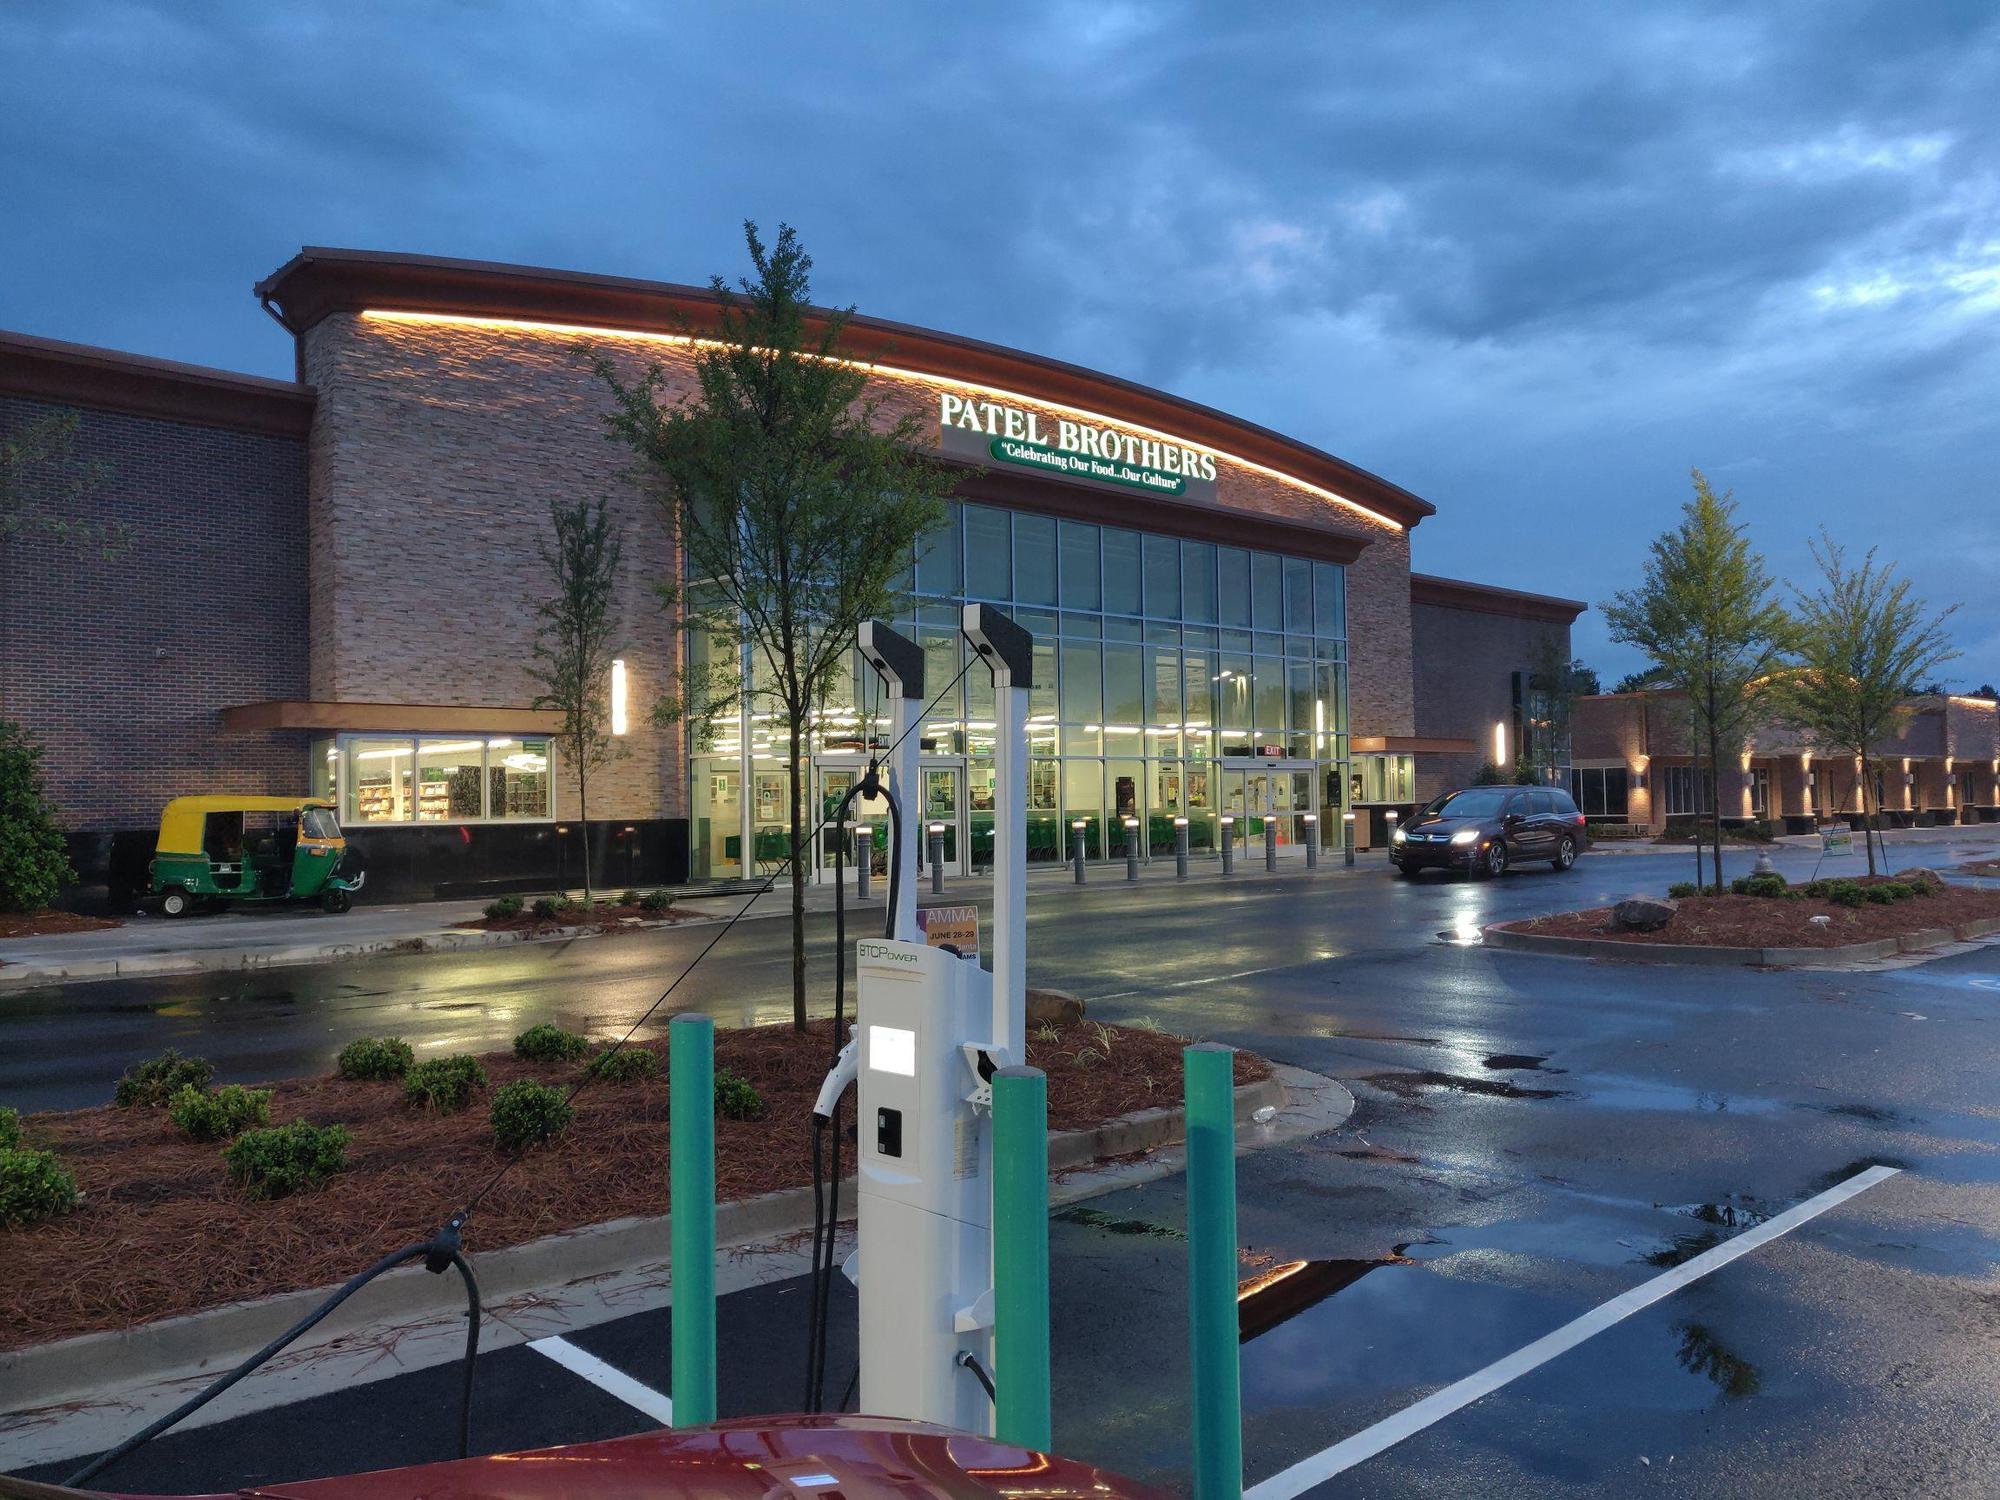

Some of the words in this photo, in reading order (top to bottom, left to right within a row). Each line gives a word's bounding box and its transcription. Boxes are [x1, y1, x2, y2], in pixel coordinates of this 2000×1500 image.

[941, 393, 1048, 446] PATEL
[1058, 420, 1217, 482] BROTHERS
[1069, 456, 1089, 472] Our
[1266, 745, 1280, 755] EXIT
[927, 908, 977, 923] AMMA
[930, 931, 951, 940] JUNE
